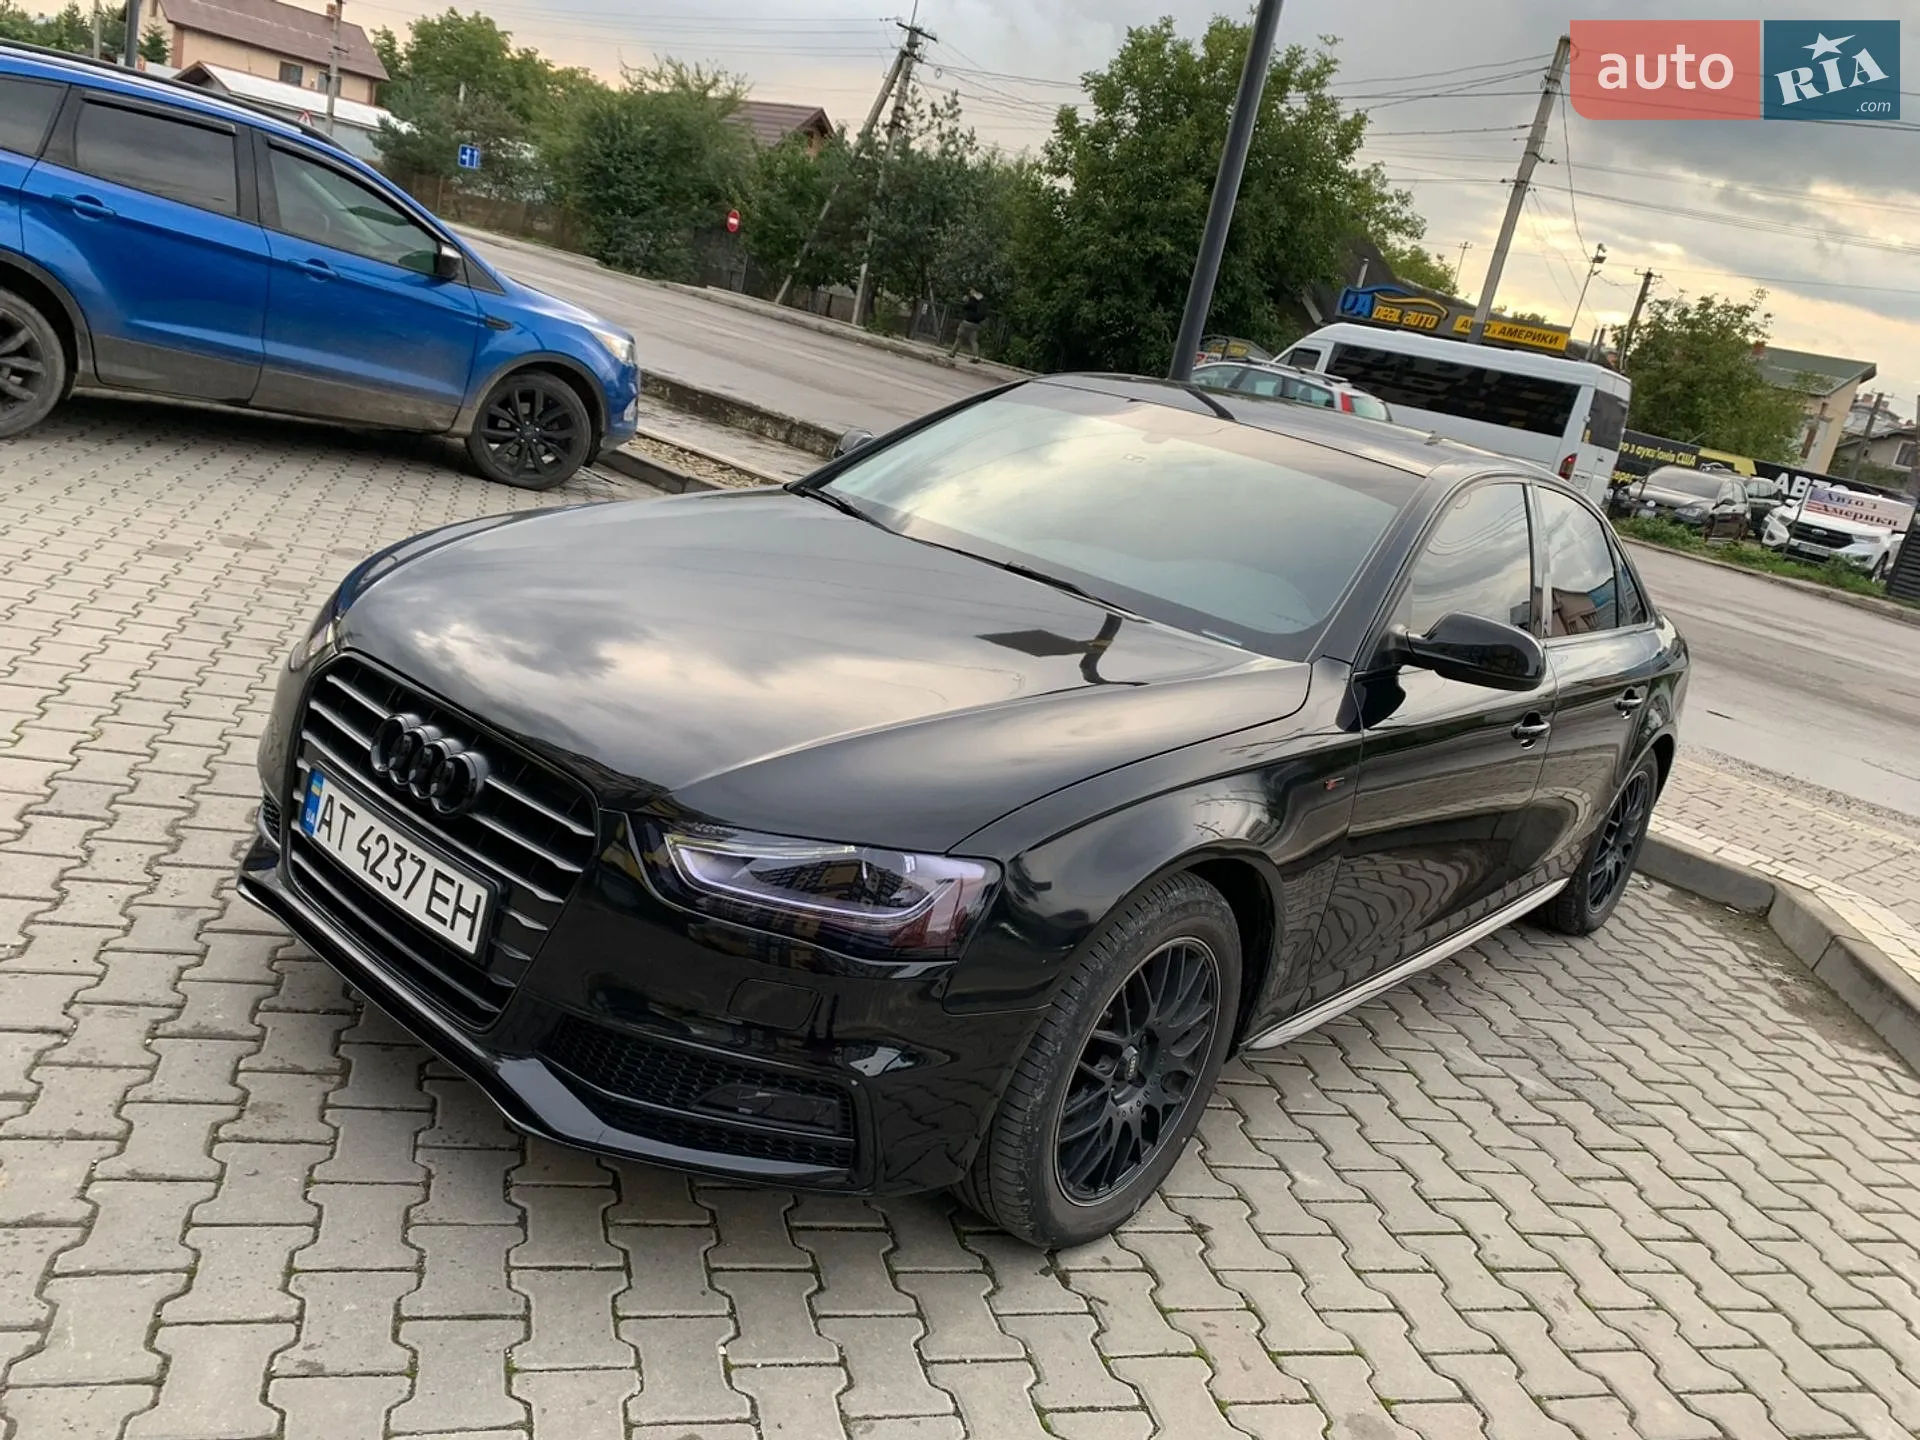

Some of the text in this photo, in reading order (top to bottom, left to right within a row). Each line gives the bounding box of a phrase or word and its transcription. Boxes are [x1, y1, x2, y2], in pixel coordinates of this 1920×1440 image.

[1498, 326, 1559, 345] АМЕРИКИ
[1820, 504, 1897, 526] Америки
[317, 793, 356, 851] AT
[356, 825, 427, 900] 4237
[425, 867, 482, 942] EH
